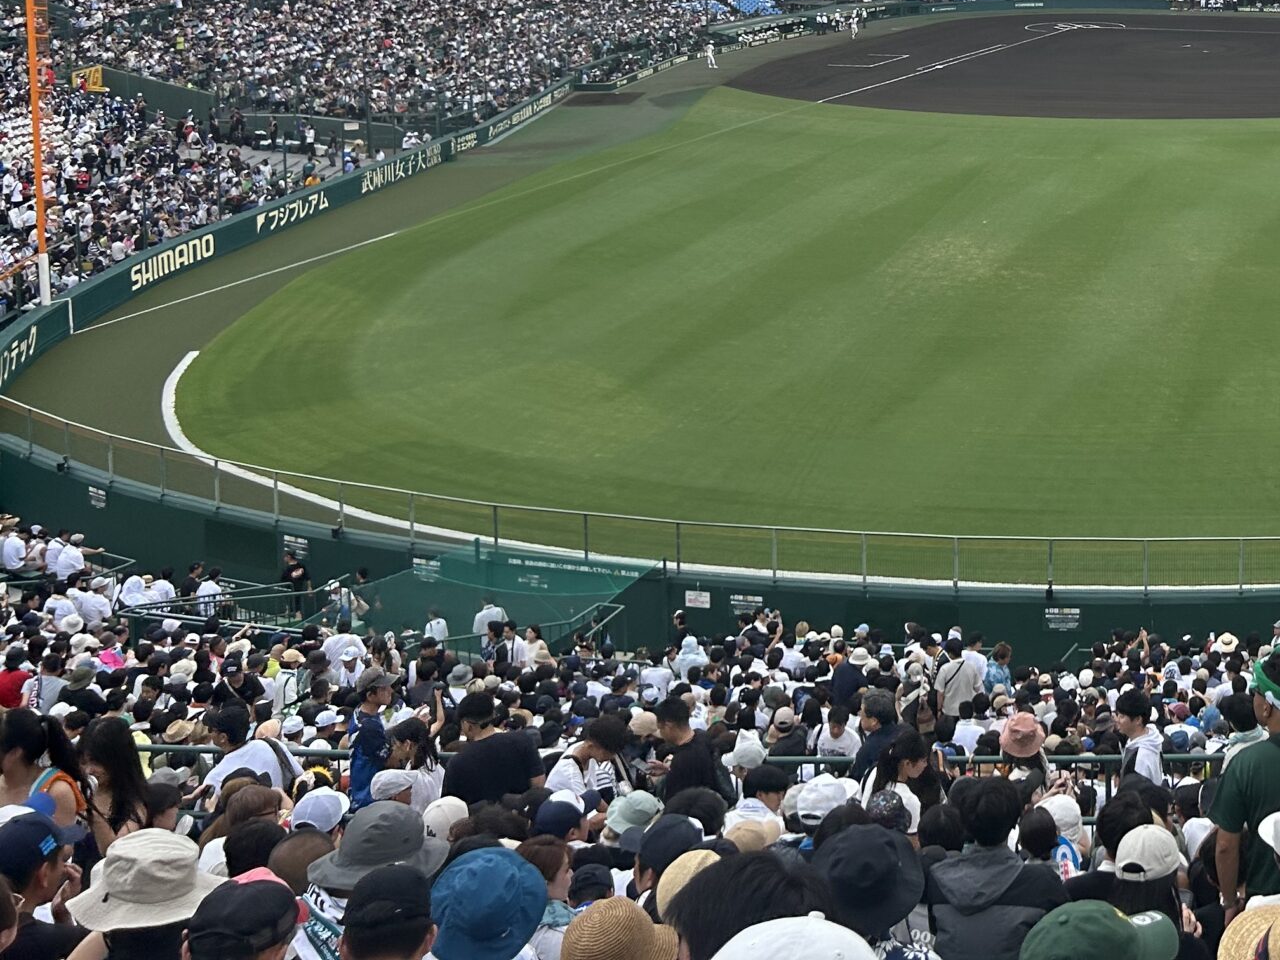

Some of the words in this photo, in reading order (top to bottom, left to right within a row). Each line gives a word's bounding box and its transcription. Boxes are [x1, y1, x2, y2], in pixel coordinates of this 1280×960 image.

[361, 152, 426, 194] 武庫川女子大
[268, 191, 329, 231] フジプレアム
[131, 234, 215, 292] SHIMANO
